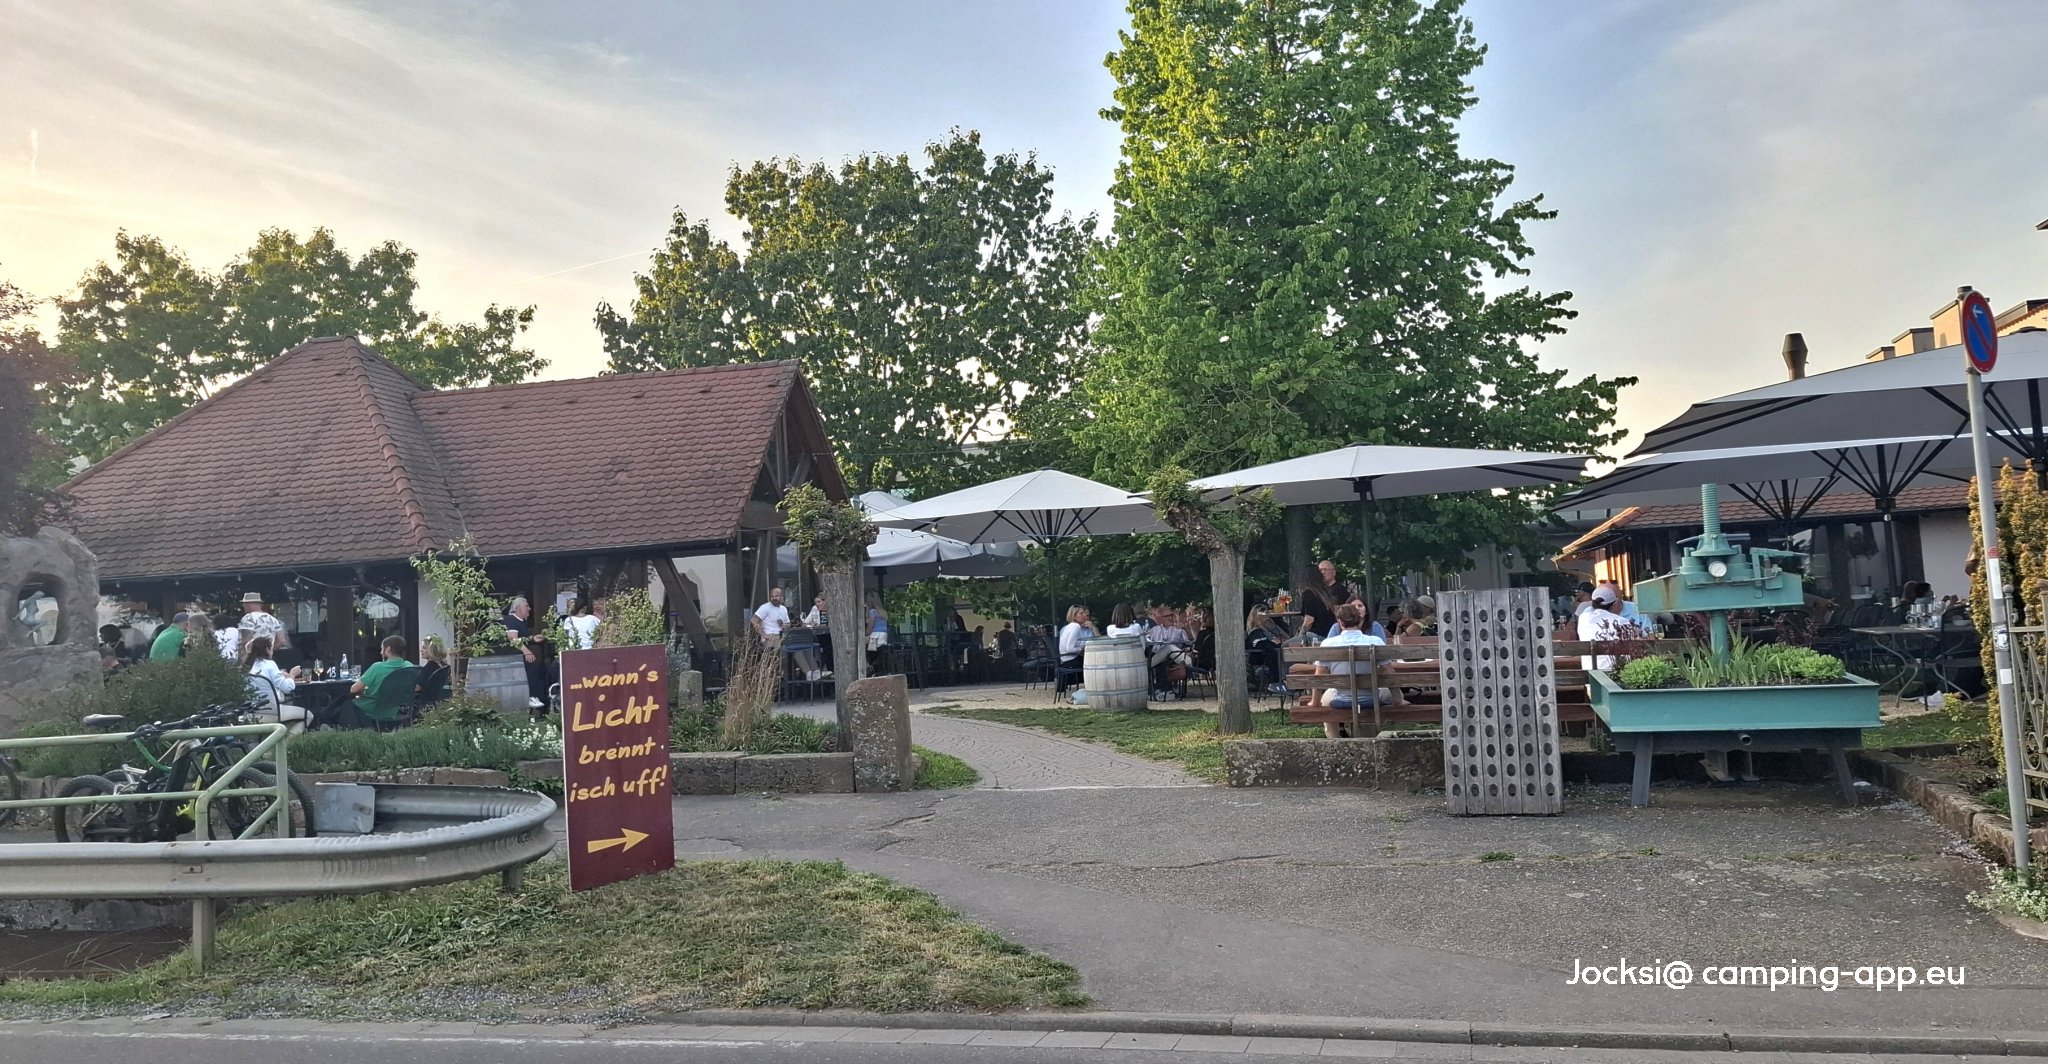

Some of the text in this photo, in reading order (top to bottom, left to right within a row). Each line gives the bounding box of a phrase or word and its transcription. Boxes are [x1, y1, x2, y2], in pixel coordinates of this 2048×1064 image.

[571, 694, 660, 733] Licht
[578, 736, 657, 765] brennt
[569, 764, 668, 803] isch uff!
